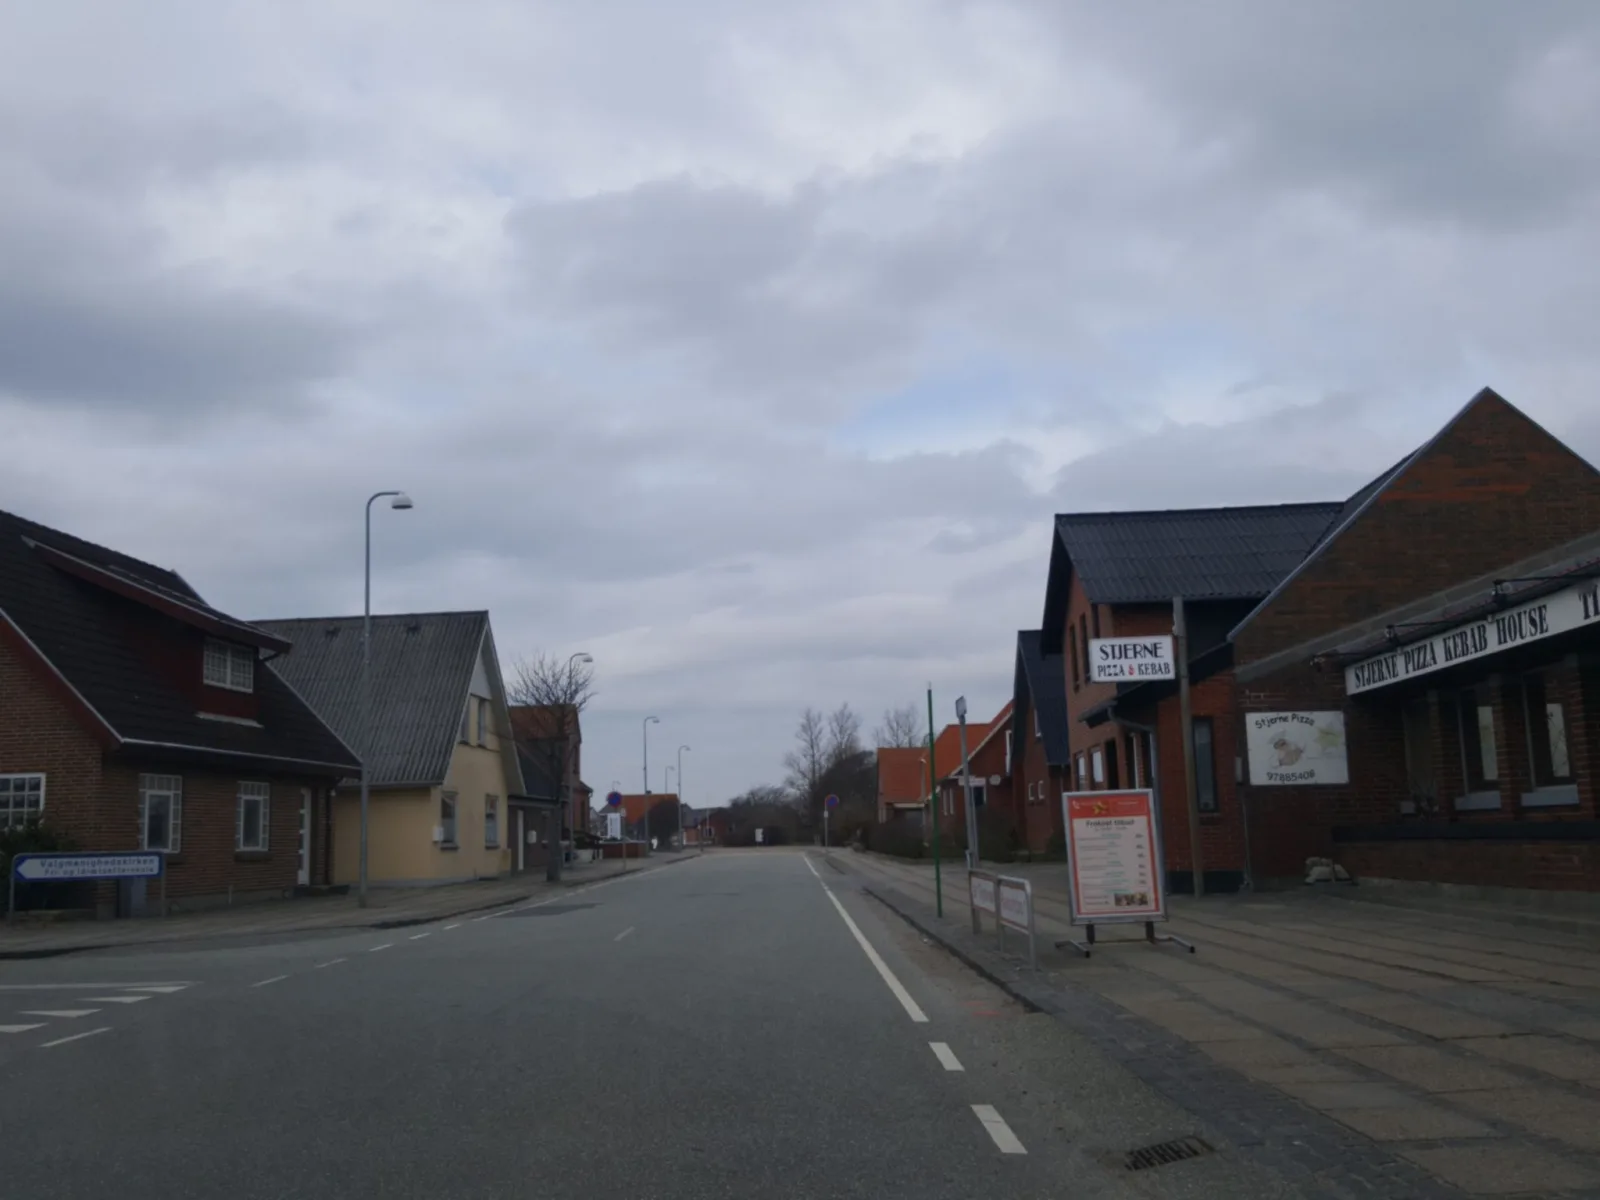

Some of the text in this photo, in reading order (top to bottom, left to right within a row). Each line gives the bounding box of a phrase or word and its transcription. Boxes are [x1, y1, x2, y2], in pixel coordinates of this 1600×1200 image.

[1099, 642, 1164, 661] STJERNE
[1354, 655, 1399, 689] STJERNE
[1404, 642, 1438, 674] PIZZA
[1443, 624, 1488, 662] KEBAB
[1495, 603, 1549, 645] HOUSE
[1097, 664, 1125, 677] PIZZA
[1137, 662, 1171, 675] KEBAB
[1255, 713, 1315, 729] Stjerne Pizza
